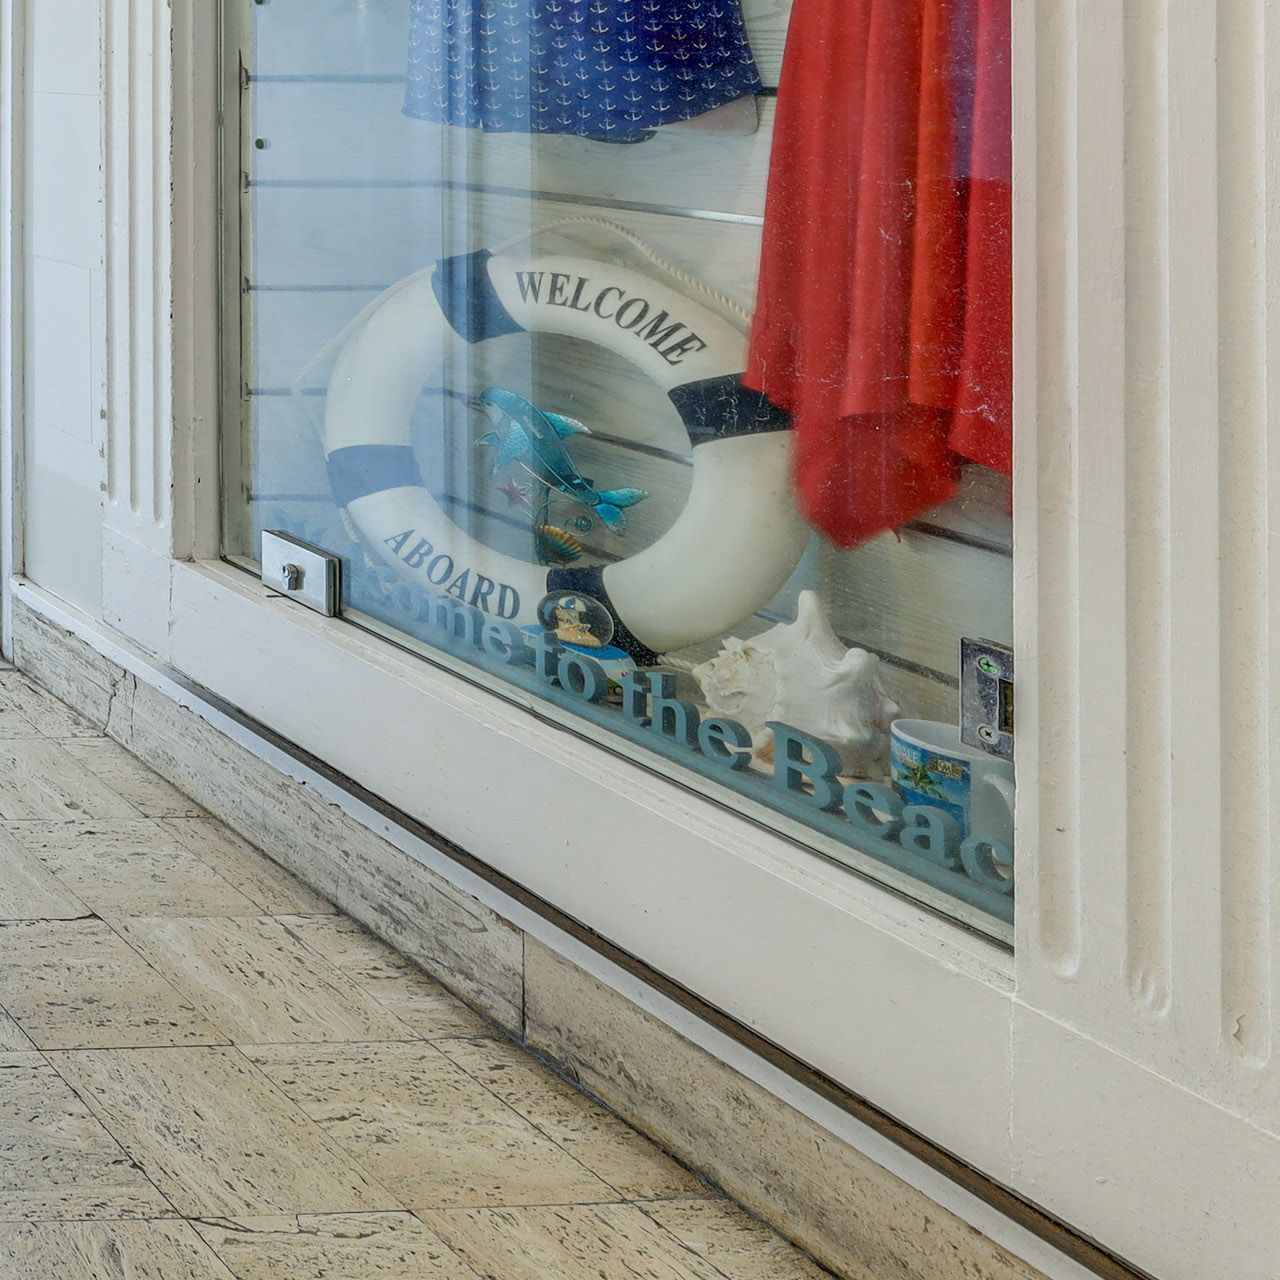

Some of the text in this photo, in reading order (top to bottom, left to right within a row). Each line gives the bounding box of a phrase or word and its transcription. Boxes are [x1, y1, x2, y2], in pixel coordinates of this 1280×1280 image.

[515, 271, 707, 366] WELCOME
[383, 528, 521, 620] ABOARD
[534, 631, 600, 701] to
[619, 670, 743, 769] the
